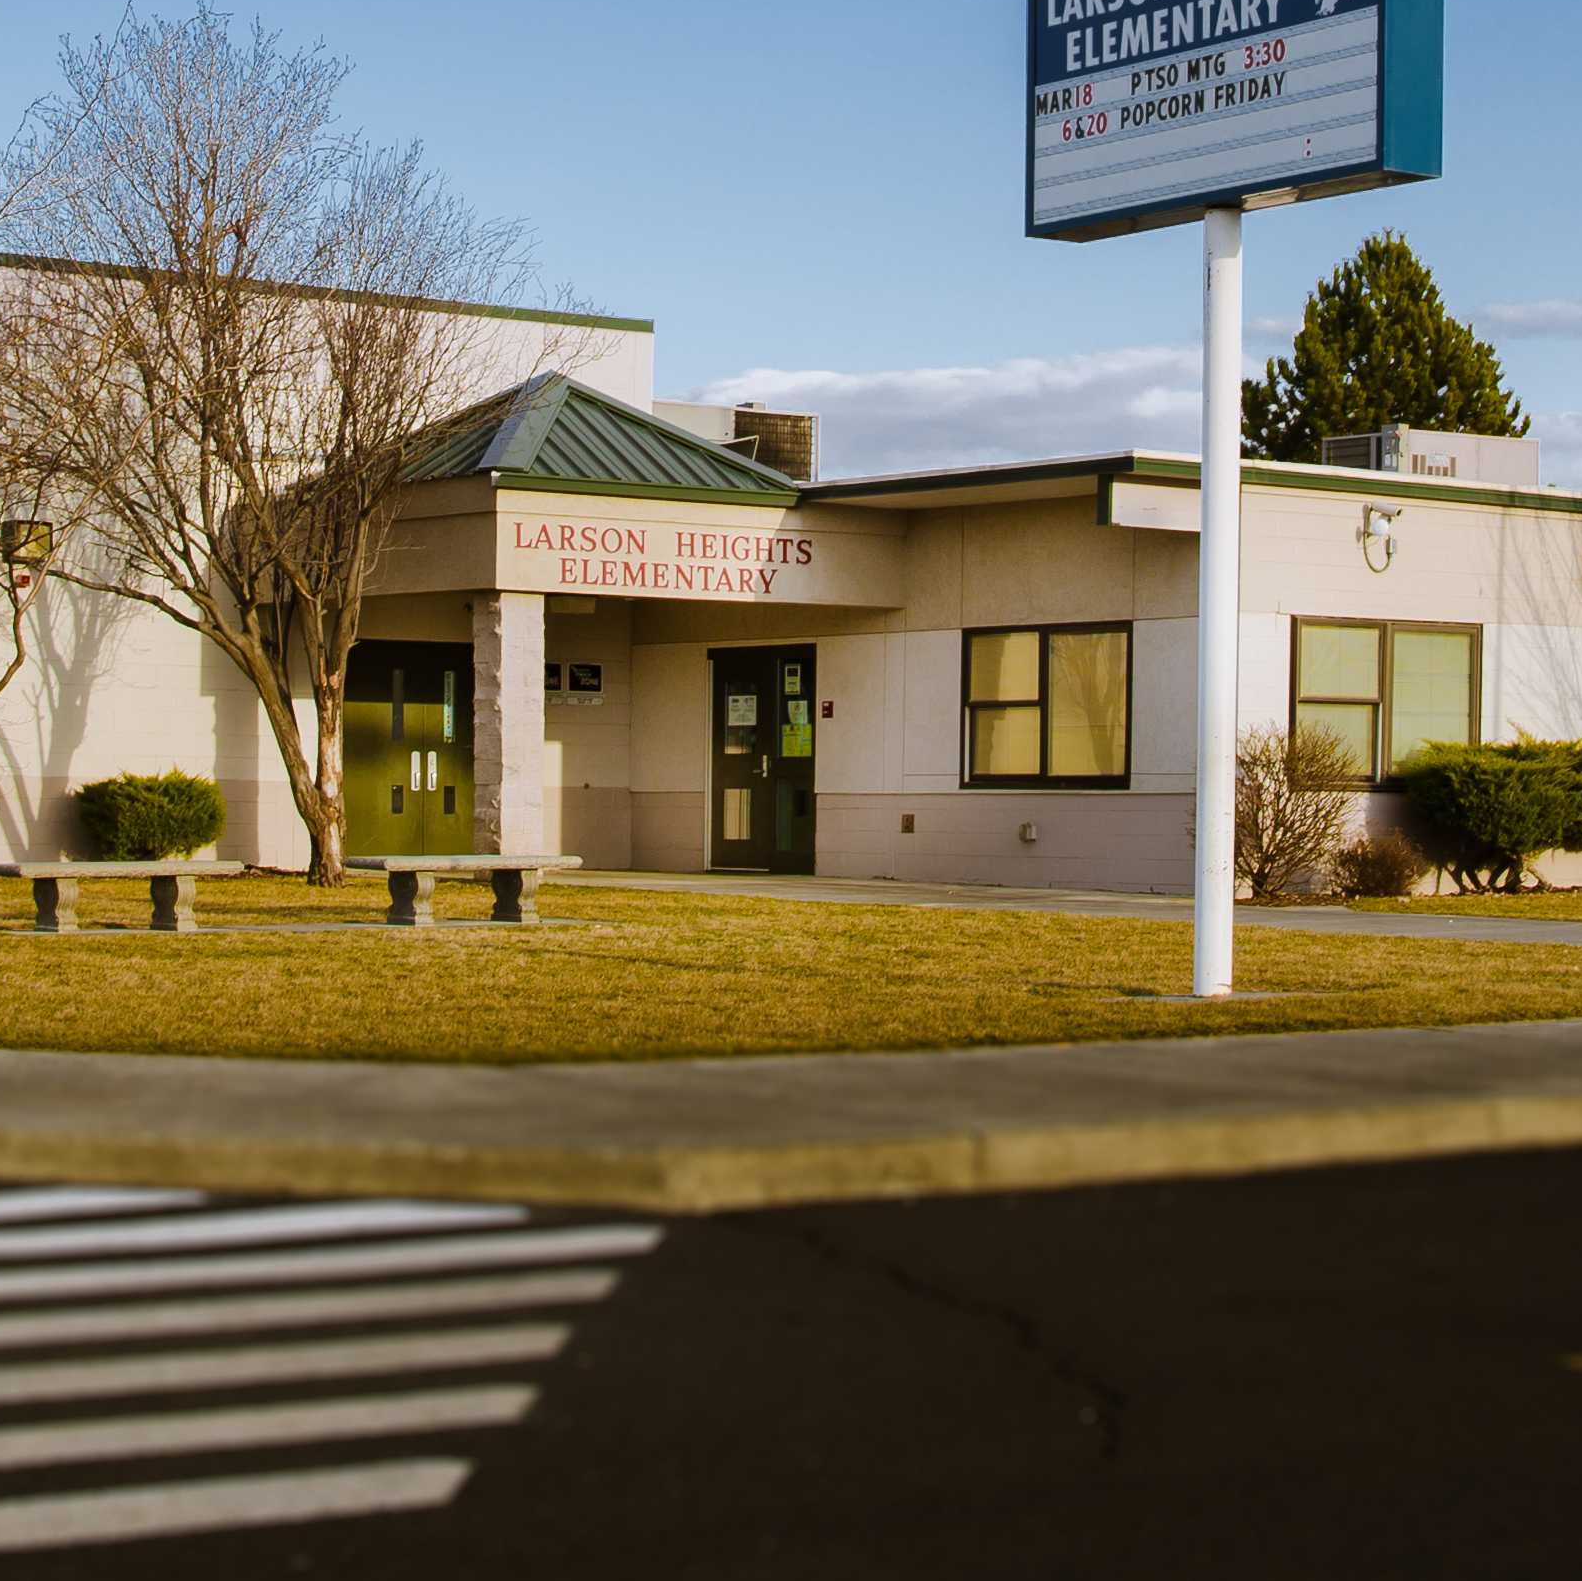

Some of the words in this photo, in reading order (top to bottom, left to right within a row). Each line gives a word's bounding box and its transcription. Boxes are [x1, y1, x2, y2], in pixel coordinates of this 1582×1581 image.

[1130, 64, 1179, 96] PTSO
[1187, 53, 1226, 83] MTG
[1243, 38, 1286, 70] 3:30
[1062, 112, 1108, 142] 6&20
[1120, 90, 1205, 130] POPCORN
[1214, 71, 1286, 110] FRIDAY
[513, 522, 647, 555] LARSON
[675, 531, 813, 565] HEIGHTS
[559, 557, 779, 595] ELEMENTARY
